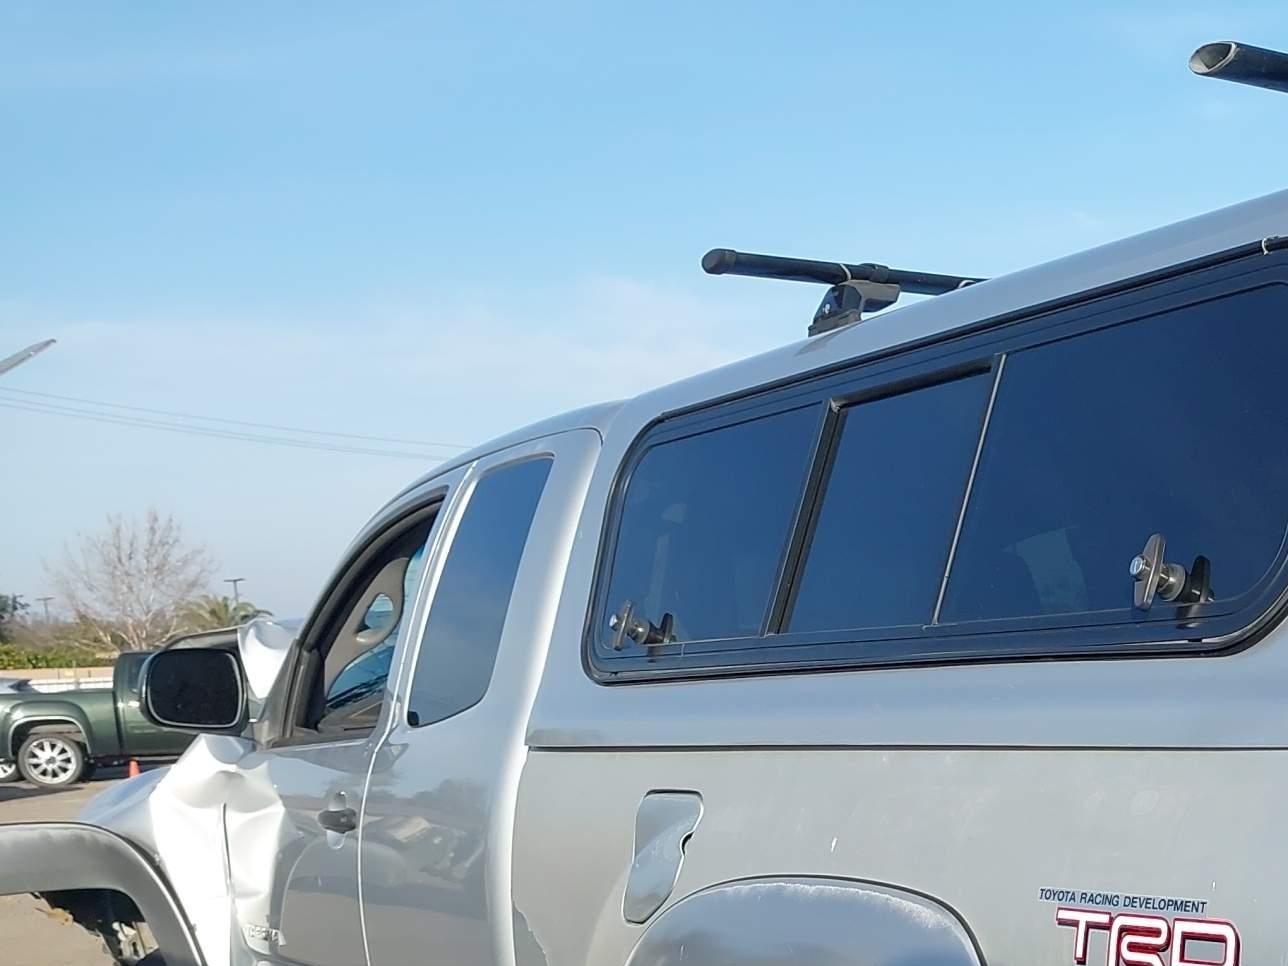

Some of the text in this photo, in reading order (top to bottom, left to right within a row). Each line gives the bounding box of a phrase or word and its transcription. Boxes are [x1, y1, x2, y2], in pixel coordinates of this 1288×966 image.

[1039, 888, 1208, 914] TOYOTA RACING DEVELOPMENT
